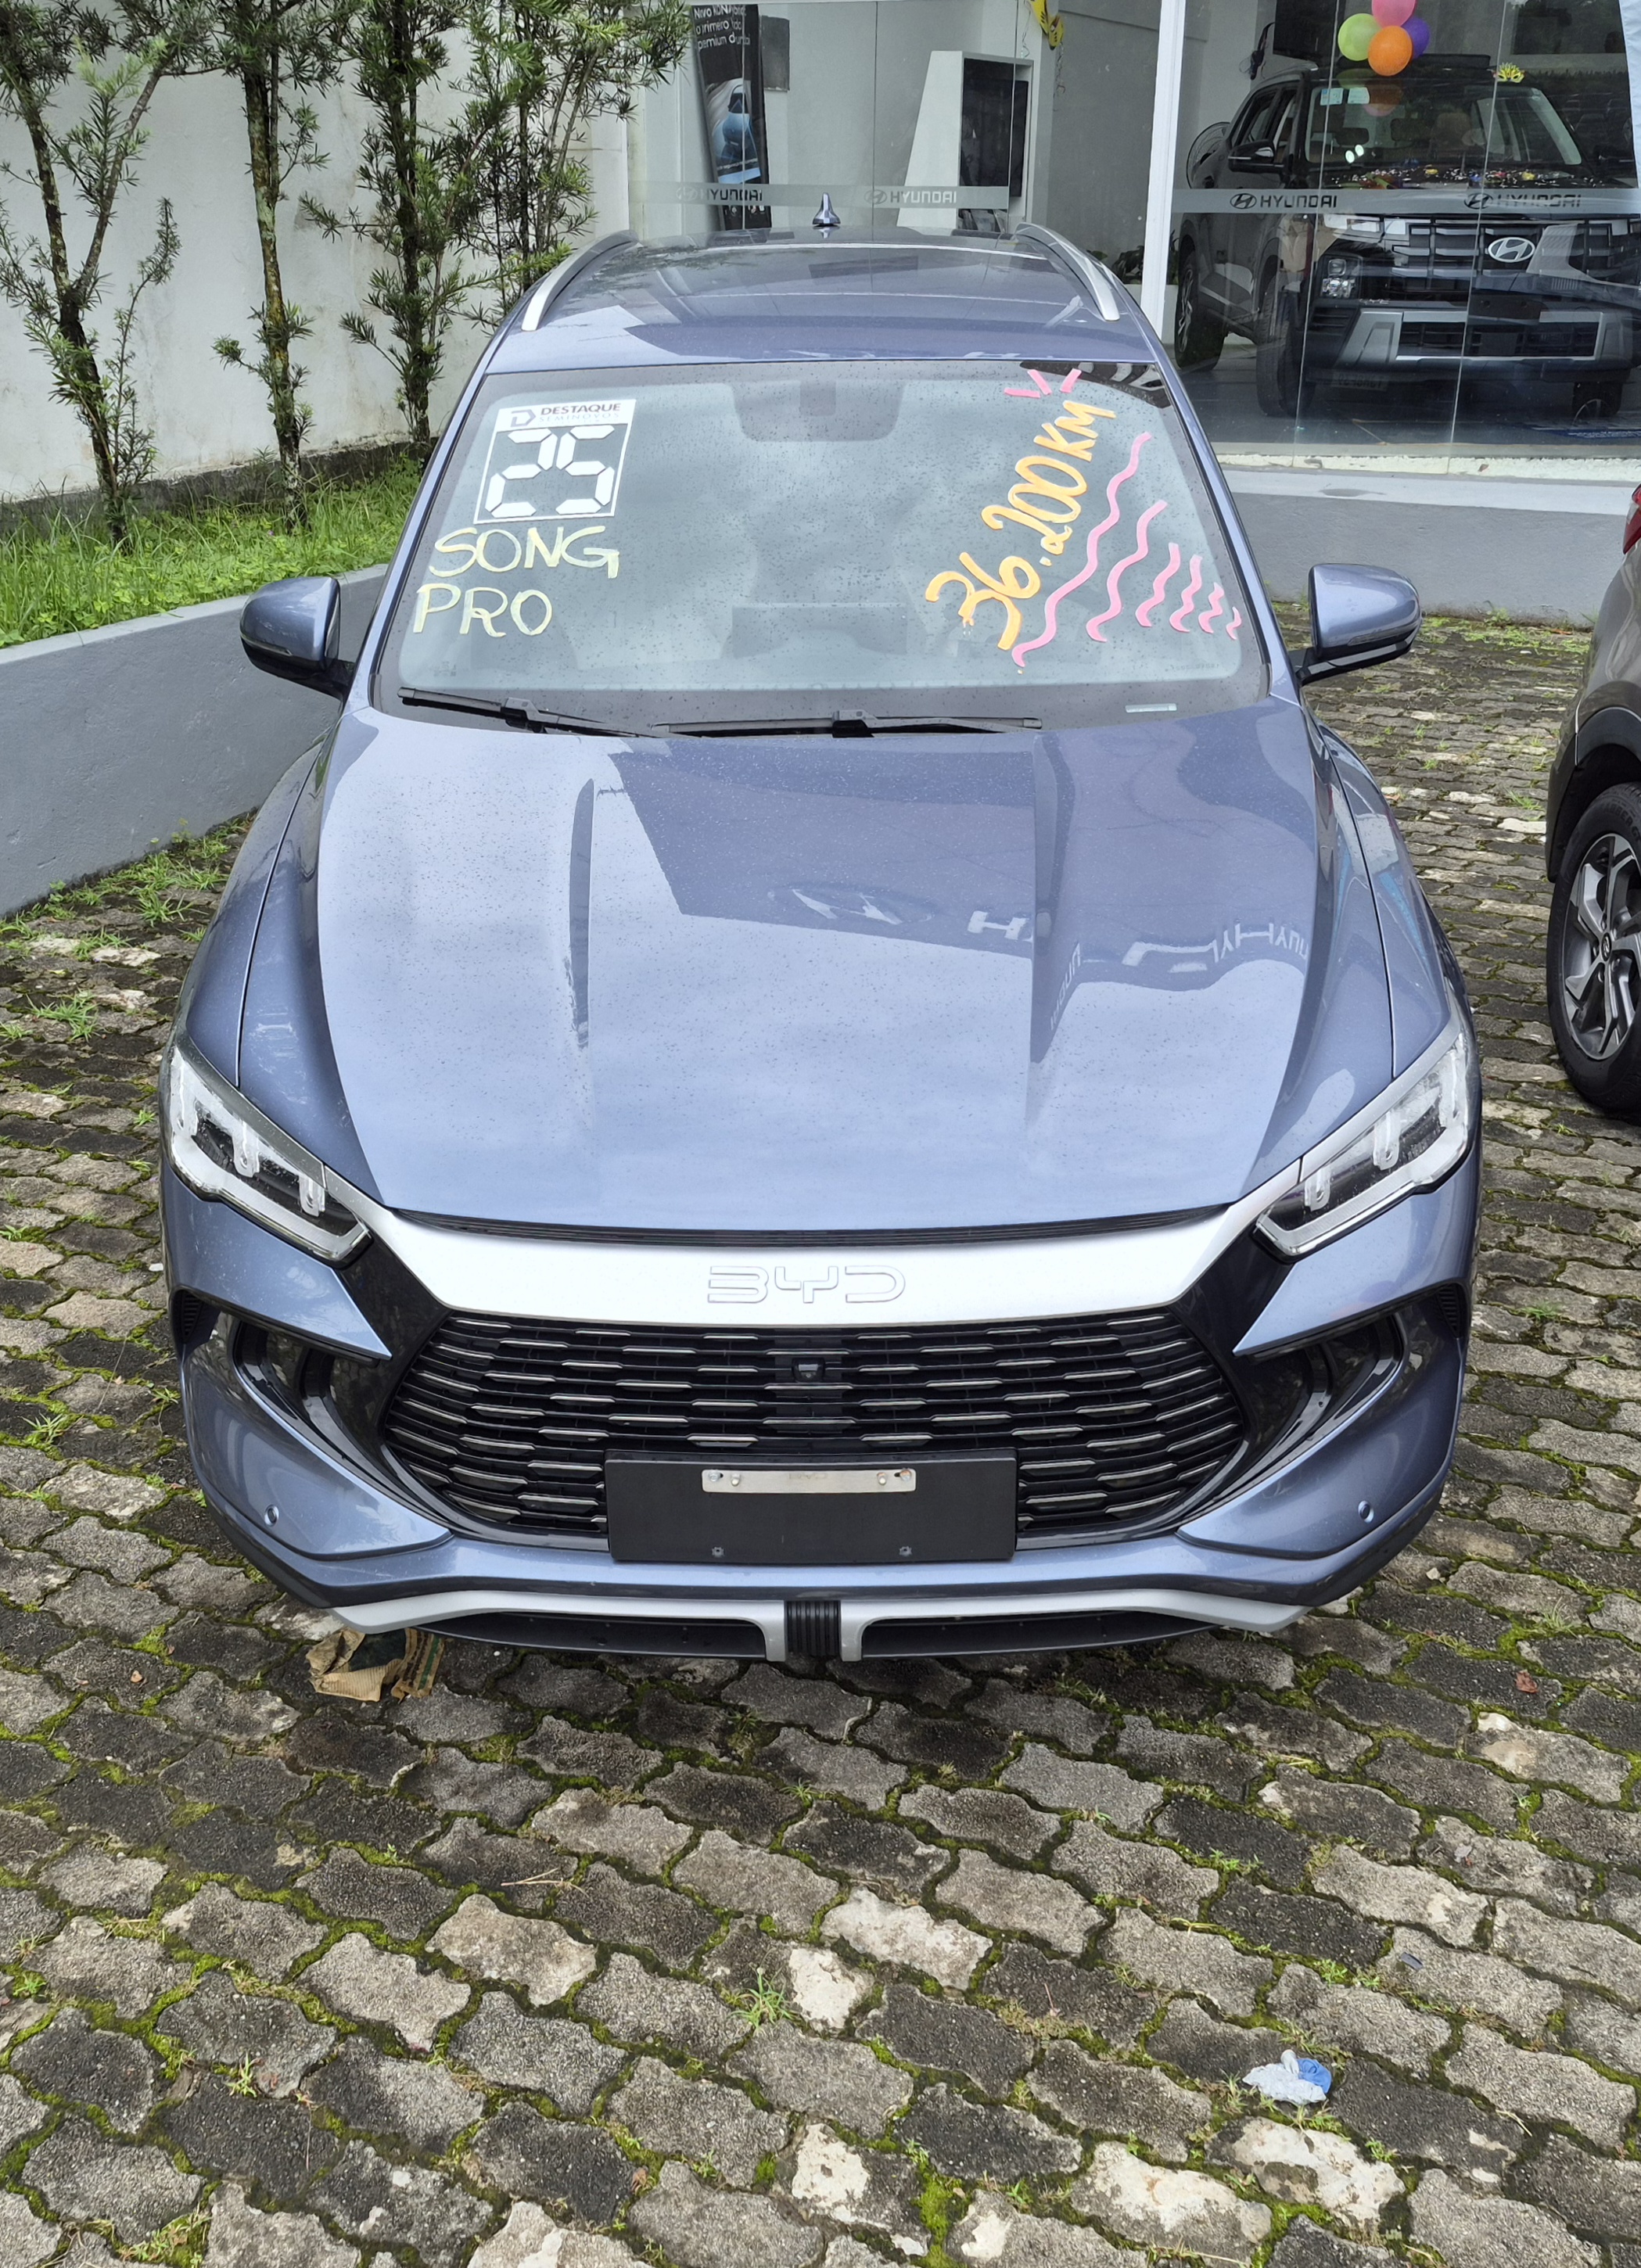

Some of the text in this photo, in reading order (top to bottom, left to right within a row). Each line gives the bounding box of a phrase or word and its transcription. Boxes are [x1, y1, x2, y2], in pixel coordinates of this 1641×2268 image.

[890, 191, 957, 203] HYUNDAI
[1260, 195, 1338, 208] HYUNDAI
[540, 403, 621, 415] DESTAQUE
[485, 425, 616, 519] 25
[429, 526, 620, 579] SONG
[413, 583, 553, 638] PRO
[707, 1265, 907, 1304] BYD
